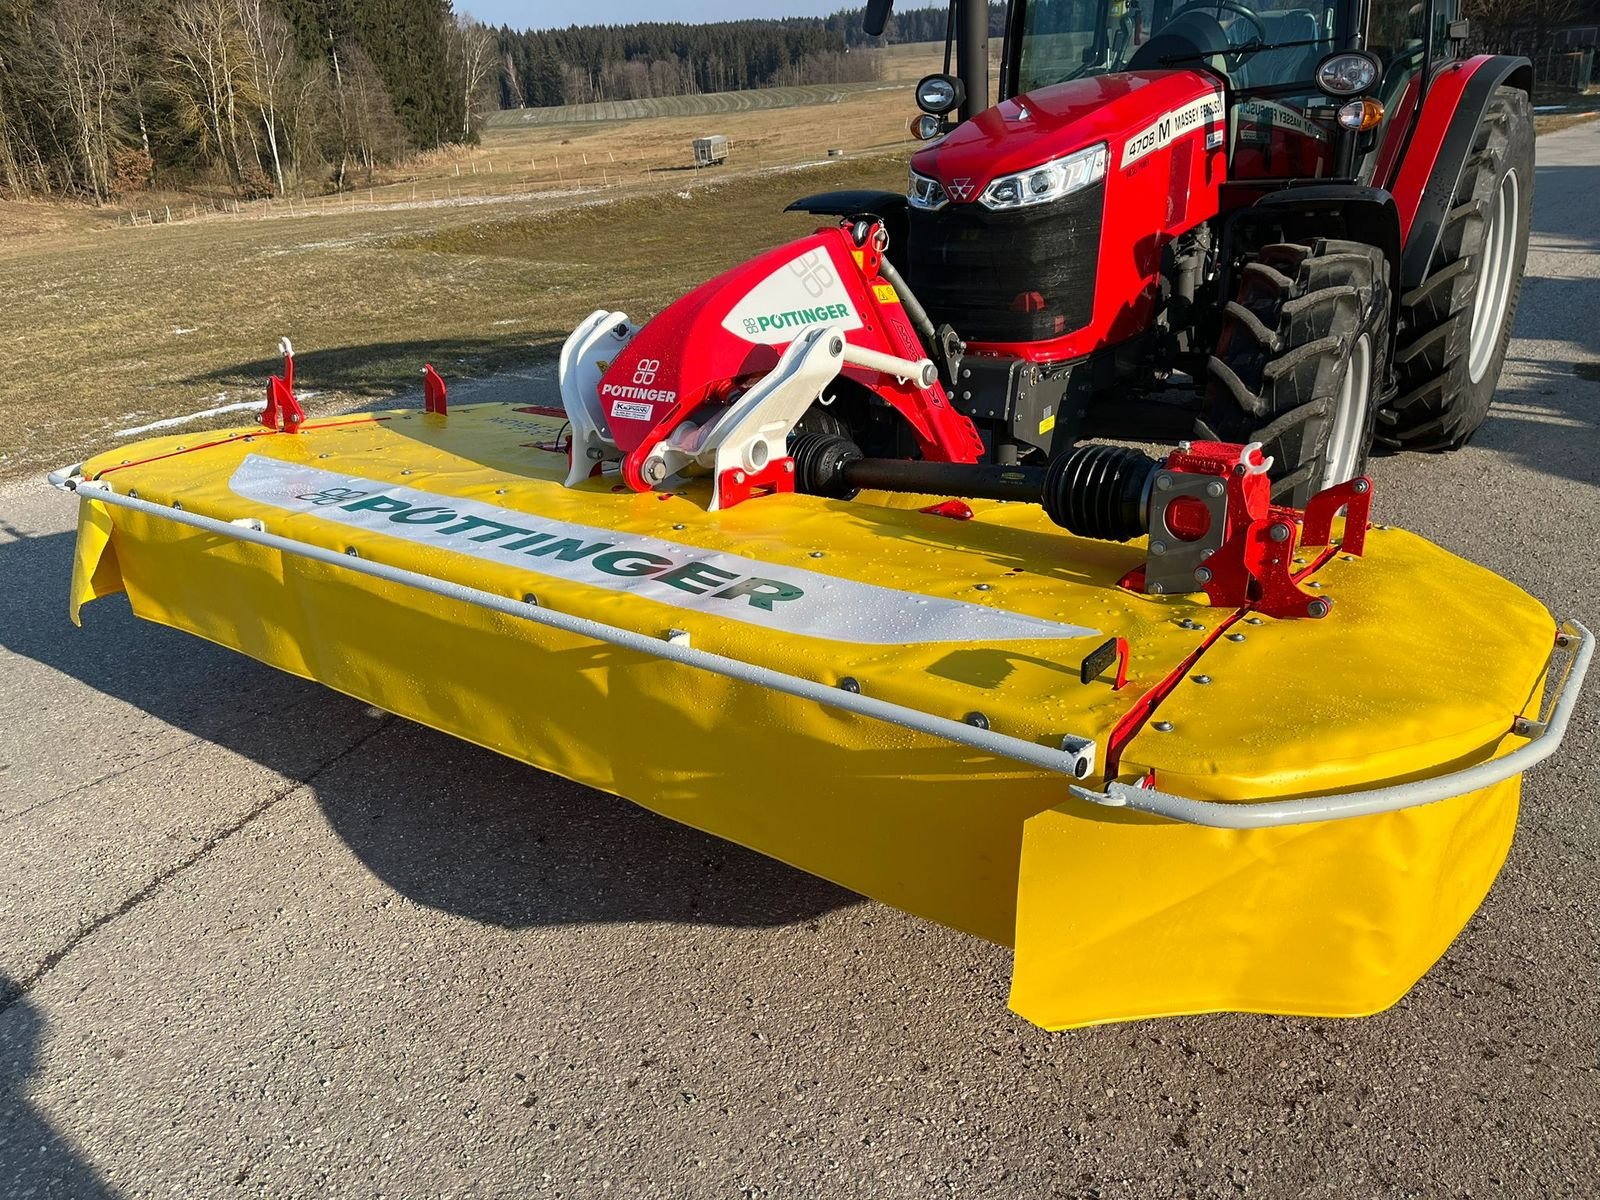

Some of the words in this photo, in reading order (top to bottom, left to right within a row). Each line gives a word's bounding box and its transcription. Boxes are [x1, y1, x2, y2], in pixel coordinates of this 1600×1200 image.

[1128, 131, 1155, 157] 4708
[1158, 118, 1171, 143] M
[1174, 106, 1199, 132] MASSEY
